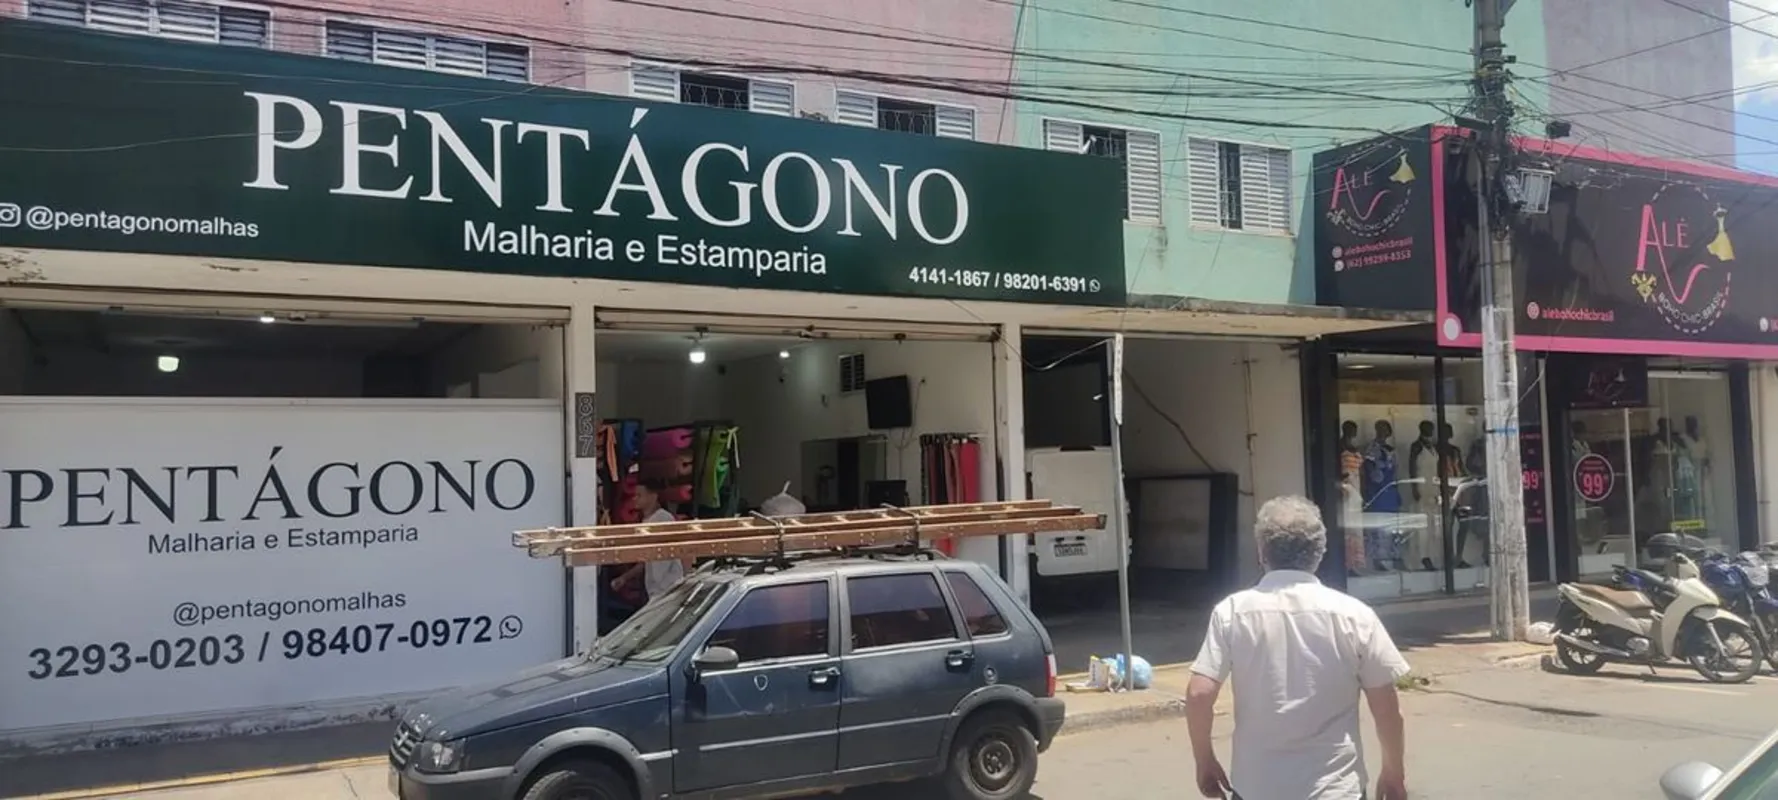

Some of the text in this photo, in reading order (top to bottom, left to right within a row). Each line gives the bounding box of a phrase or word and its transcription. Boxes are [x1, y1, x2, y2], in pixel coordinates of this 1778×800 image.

[243, 91, 969, 244] PENTÁGONO
[27, 205, 259, 238] @pentagonomalhas
[464, 220, 827, 277] Malharia e Estamparia
[909, 266, 1087, 293] 4141-1867 / 98201-6391
[1, 446, 535, 529] PENTÁGONO
[1583, 473, 1603, 495] 99
[148, 524, 418, 555] Malharia e Estamparia
[173, 591, 406, 627] @pentagonomalhas
[28, 615, 492, 680] 3293-0203 / 98407-0972
